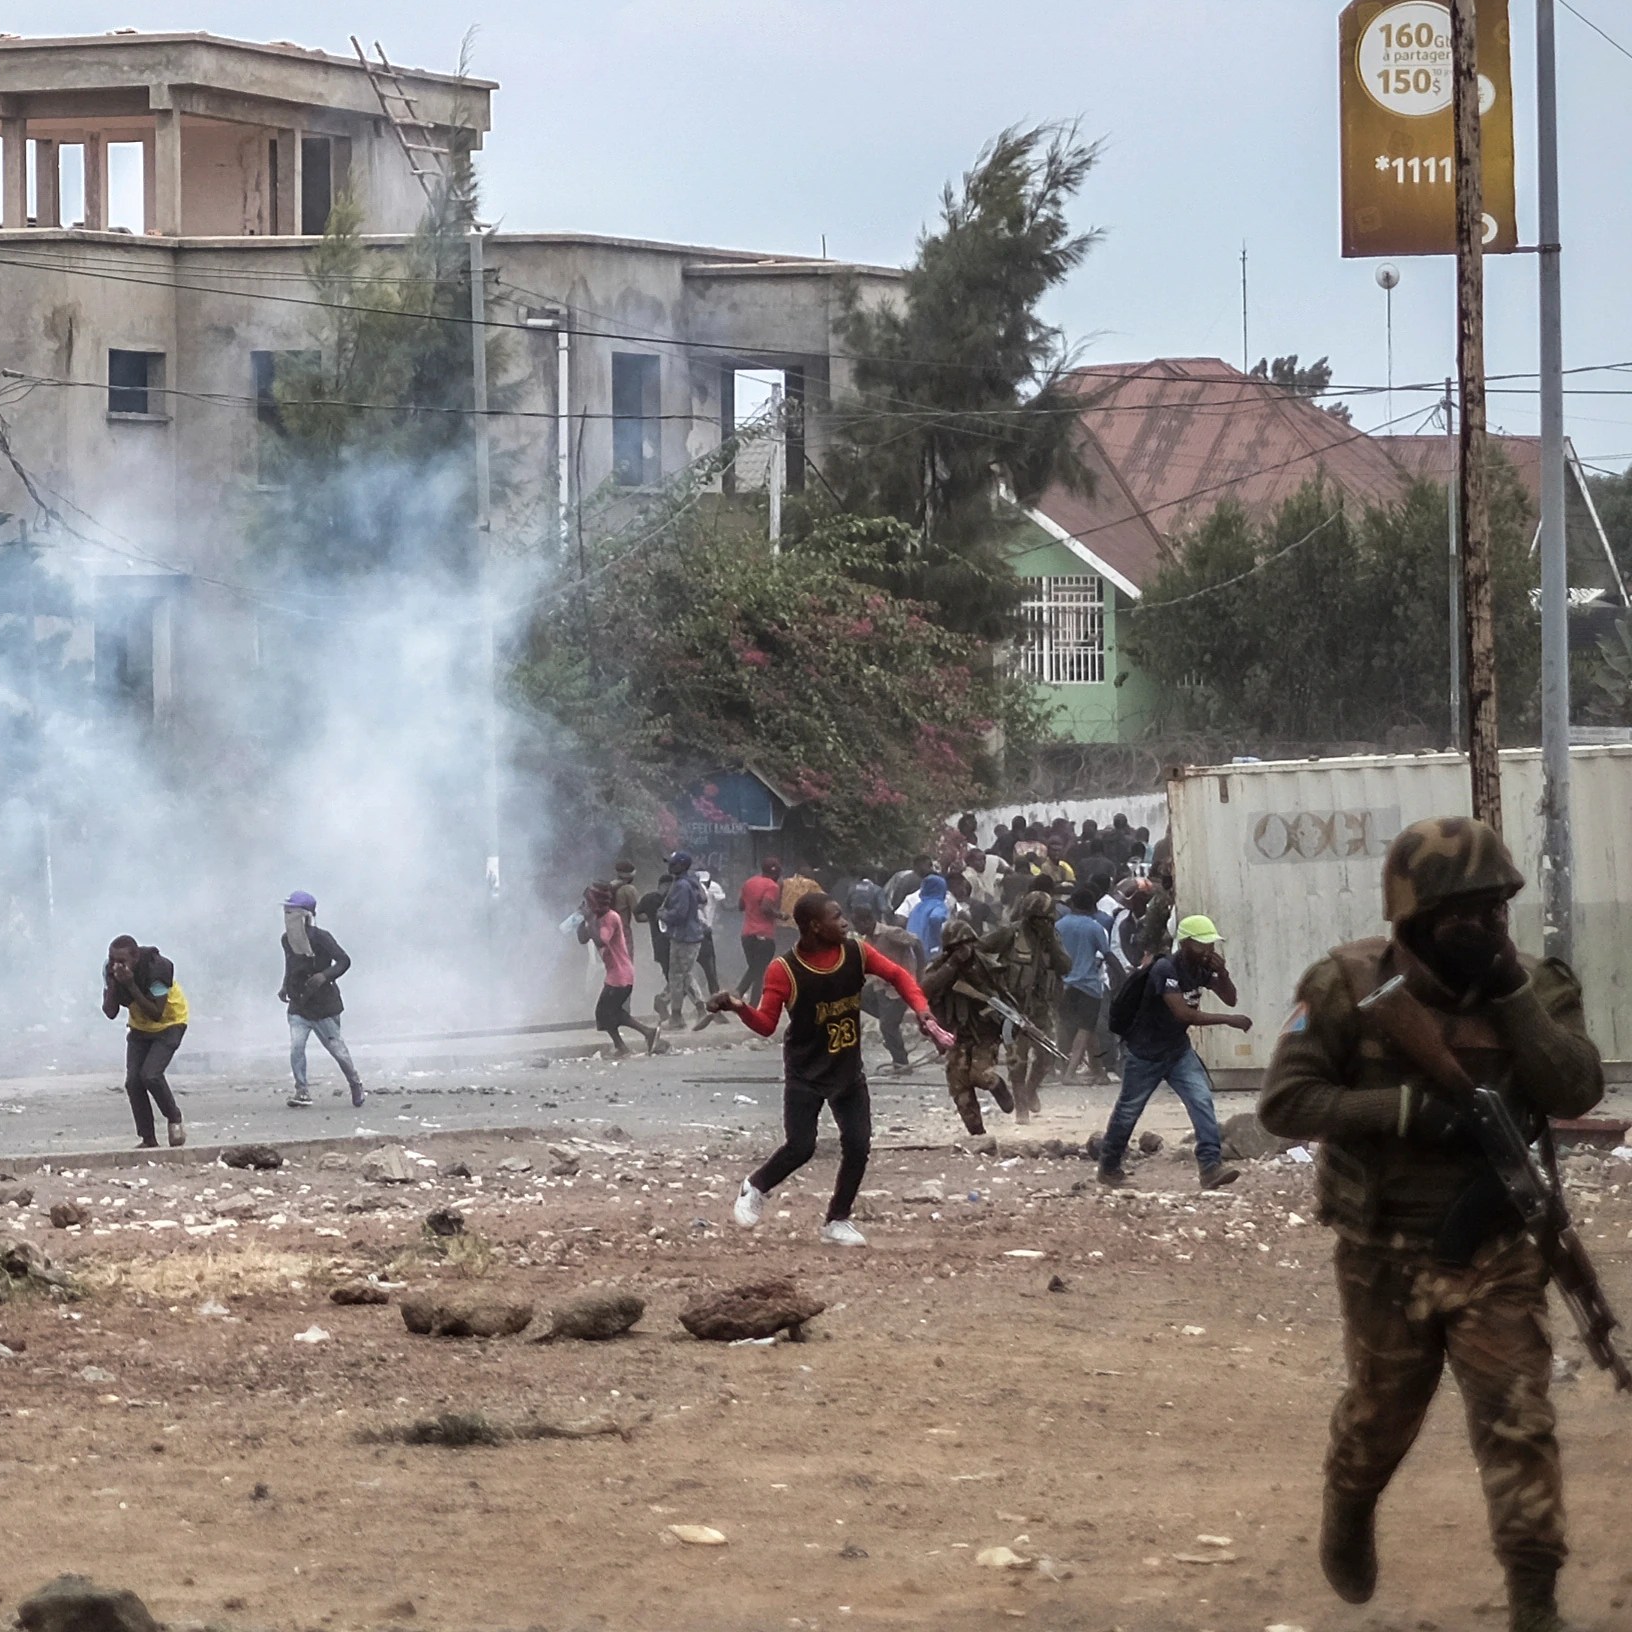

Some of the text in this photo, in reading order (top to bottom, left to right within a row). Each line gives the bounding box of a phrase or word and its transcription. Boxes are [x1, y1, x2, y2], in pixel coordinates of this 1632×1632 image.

[1382, 47, 1452, 63] à partager
[1377, 68, 1431, 95] 150
[827, 1018, 857, 1053] 23
